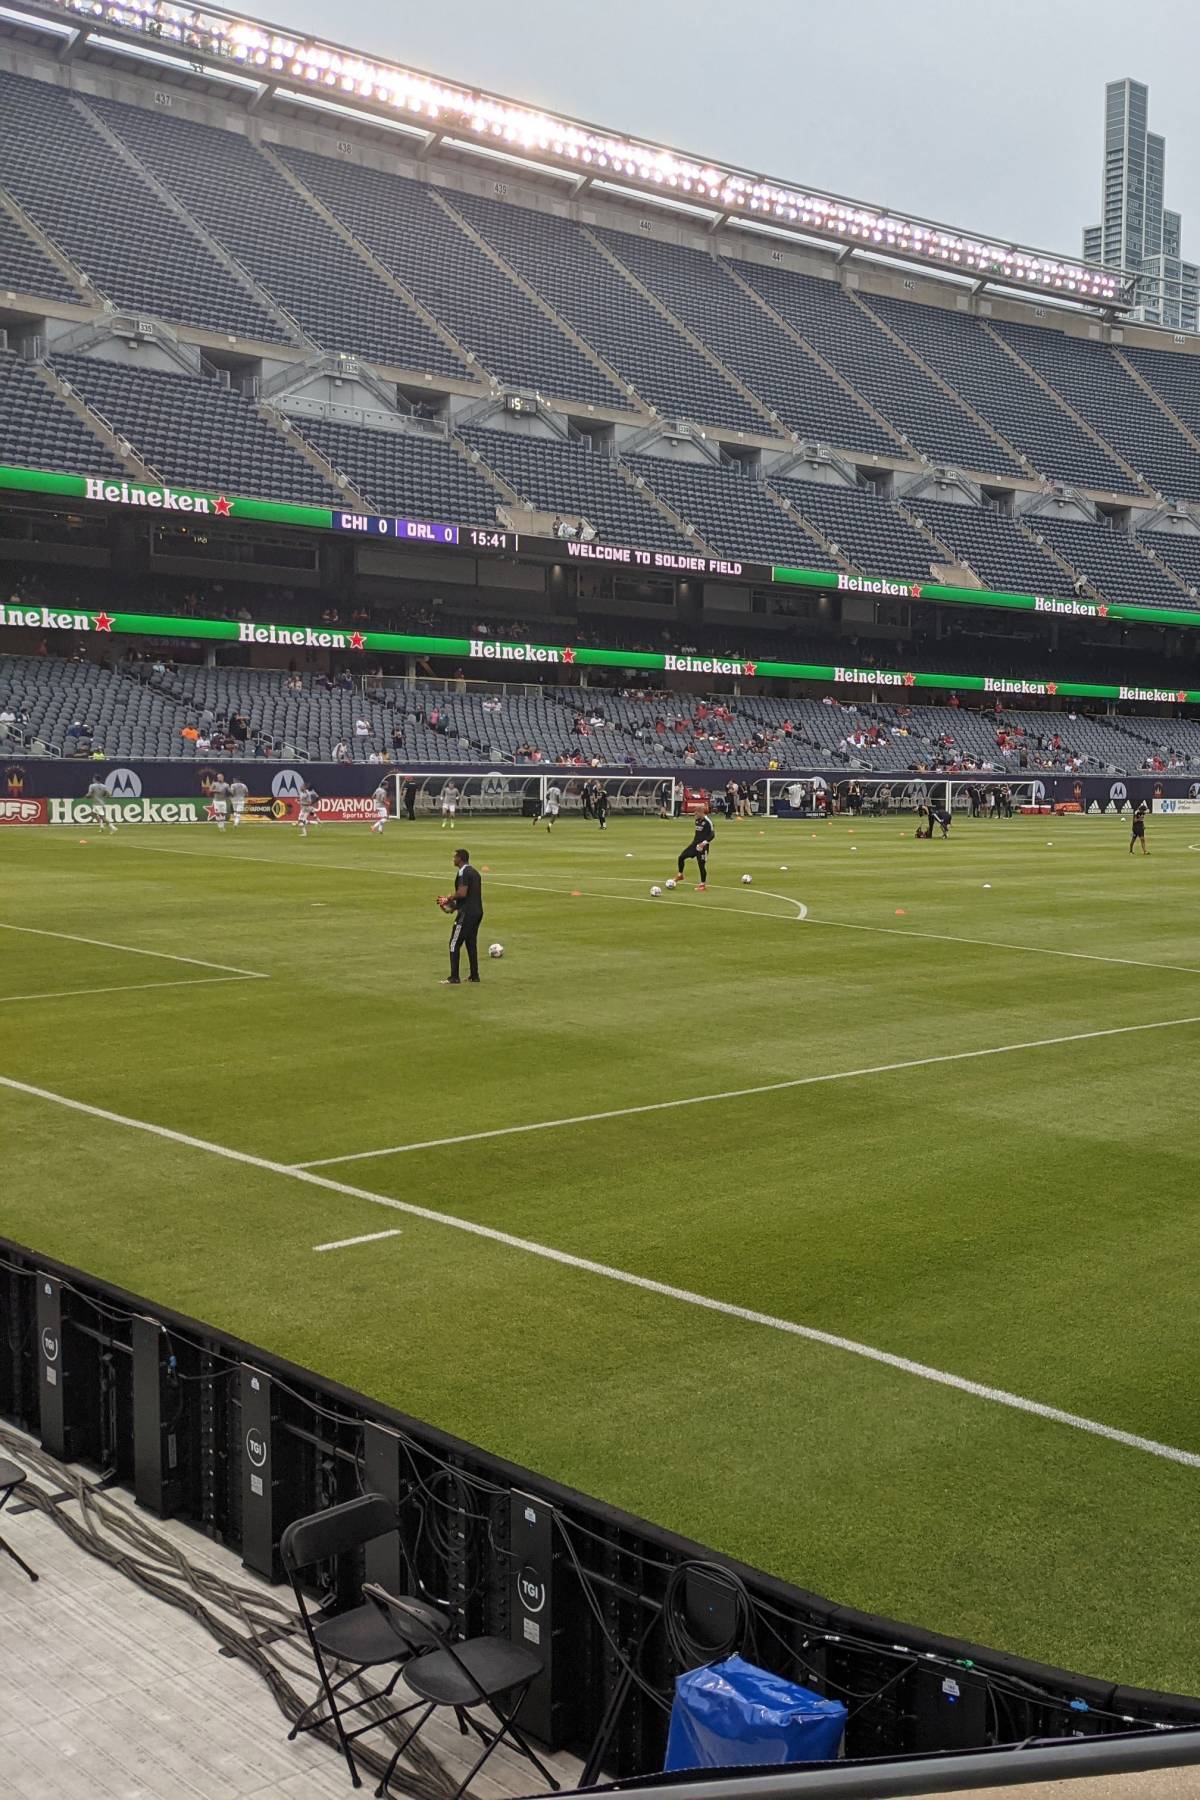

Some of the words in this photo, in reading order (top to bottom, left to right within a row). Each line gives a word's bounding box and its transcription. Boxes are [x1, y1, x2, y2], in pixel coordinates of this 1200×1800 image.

[156, 93, 171, 105] 437
[338, 142, 352, 153] 438
[494, 184, 507, 194] 439
[640, 220, 651, 231] 440
[772, 251, 784, 262] 441
[904, 280, 915, 290] 442
[85, 478, 210, 514] Heineken
[341, 514, 367, 531] CHI
[378, 519, 388, 534] 0
[407, 522, 435, 539] ORL
[444, 528, 453, 542] 0
[470, 531, 507, 549] 15:41
[567, 542, 631, 562] WELCOME
[634, 551, 650, 564] TO
[655, 553, 706, 572] SOLDIER
[709, 560, 742, 575] FIELD
[837, 574, 909, 597] Heineken
[1034, 597, 1096, 617] Heineken
[238, 622, 345, 649] Heineken
[469, 640, 559, 662] Heineken
[664, 655, 742, 675] Heineken
[833, 667, 902, 686] Heineken
[984, 678, 1045, 695] Heineken
[1119, 686, 1176, 702] Heineken
[50, 798, 198, 823] Heneken
[314, 798, 377, 812] ODYARMO
[250, 1439, 262, 1456] TGI
[522, 1580, 539, 1599] TGI
